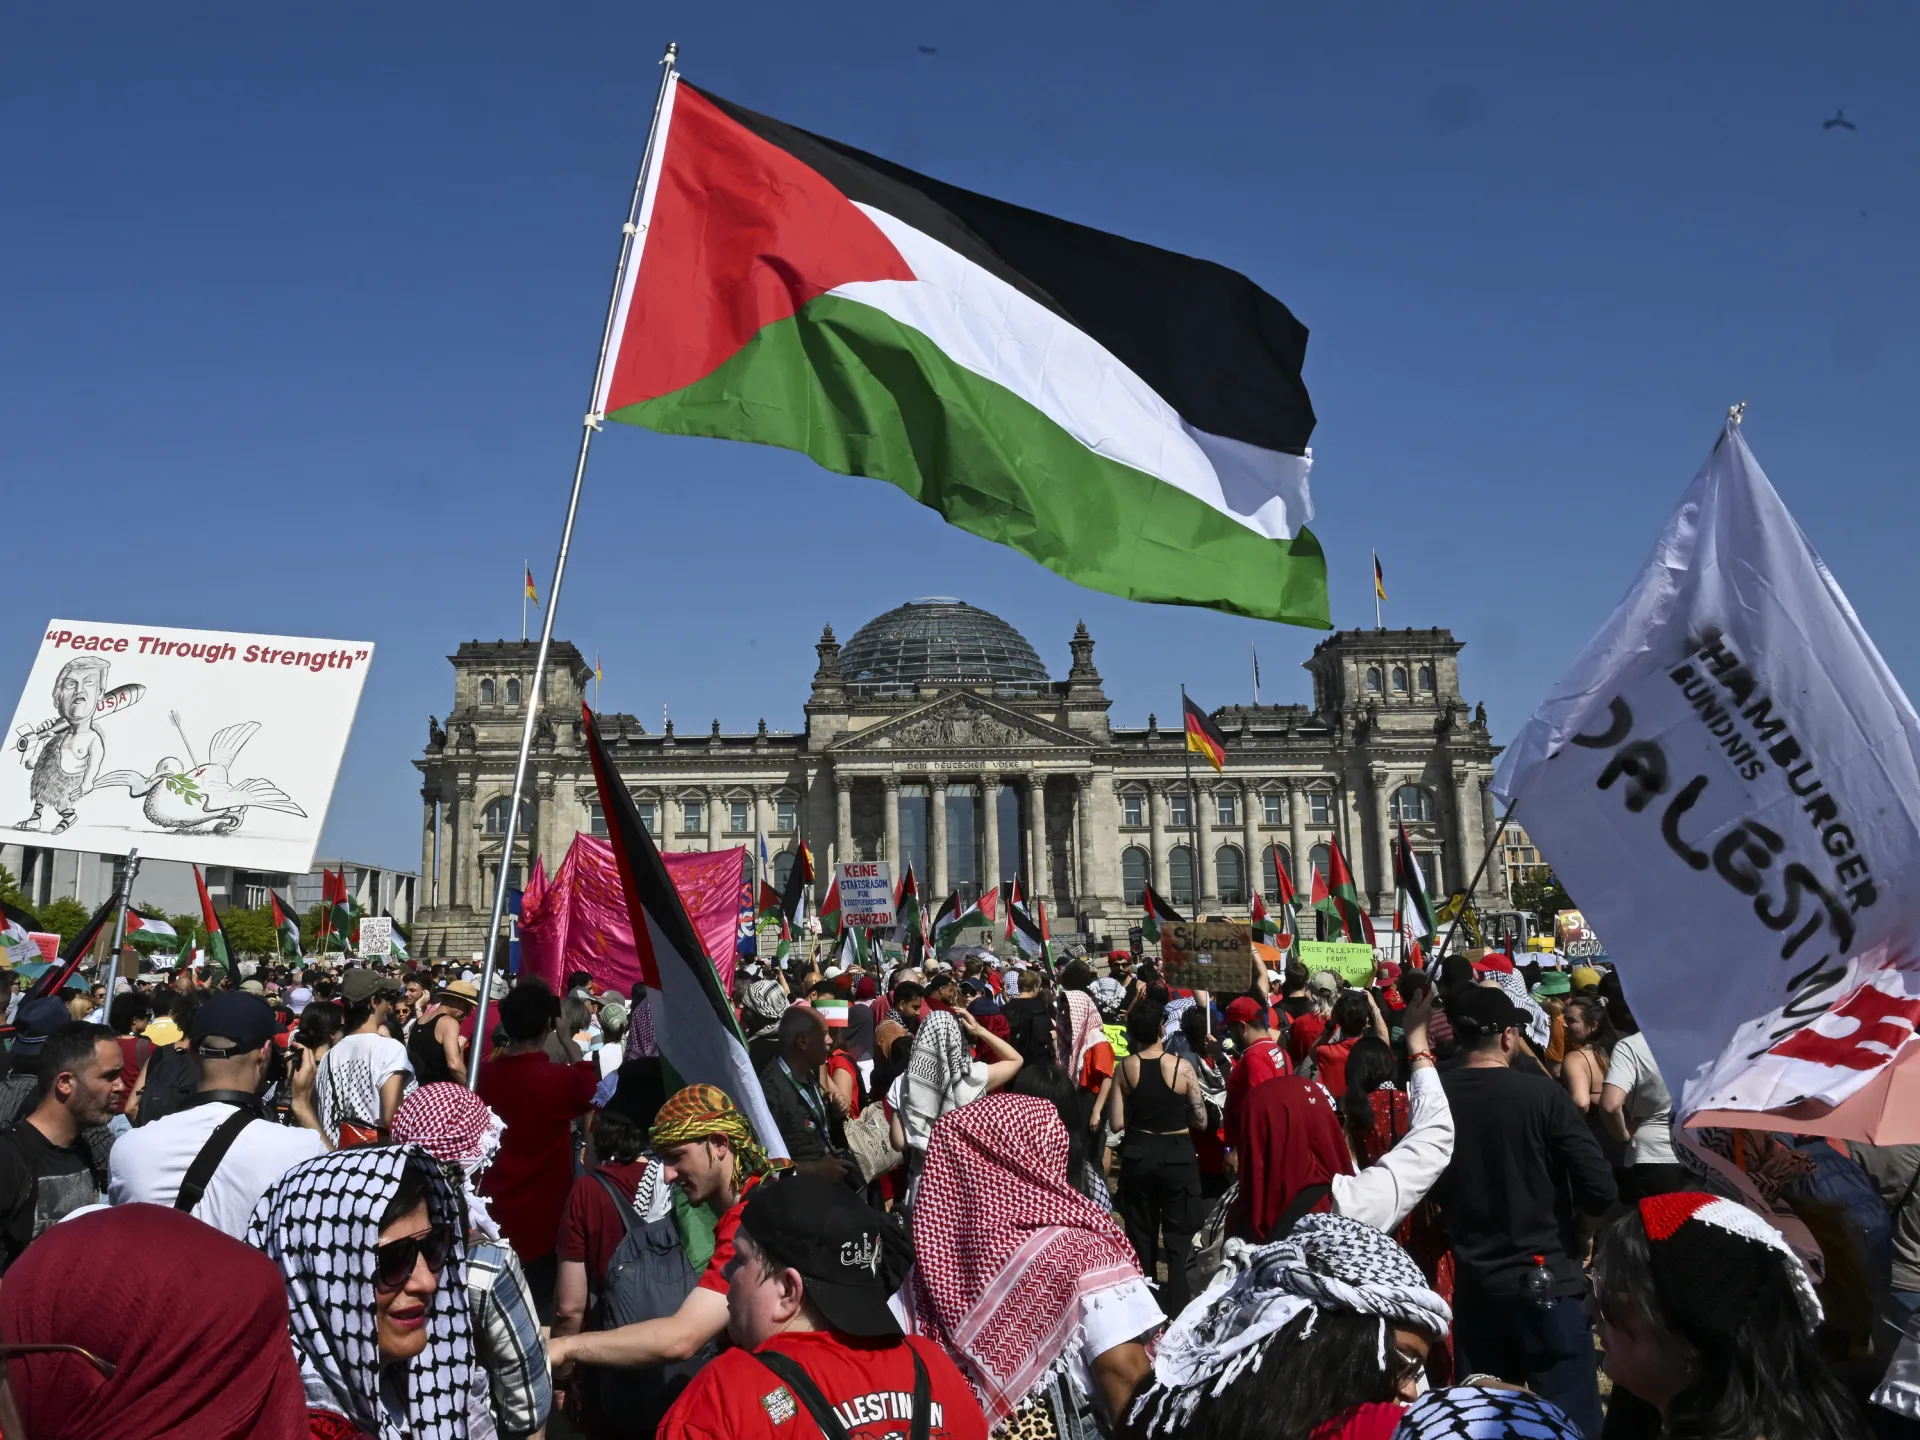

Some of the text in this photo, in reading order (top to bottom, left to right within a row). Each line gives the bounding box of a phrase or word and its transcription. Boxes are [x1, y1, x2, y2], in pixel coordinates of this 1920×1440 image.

[138, 636, 237, 663] Through
[96, 691, 127, 712] USA
[907, 760, 1020, 770] DEM DEUTSCHEN VOLKE
[1699, 636, 1878, 915] HAMBURGER
[844, 864, 879, 878] KEINE
[845, 912, 893, 925] GENOZID!
[1325, 946, 1371, 955] PALESTINE
[1325, 955, 1347, 963] FROM
[1310, 964, 1370, 975] ERMAN GUILT
